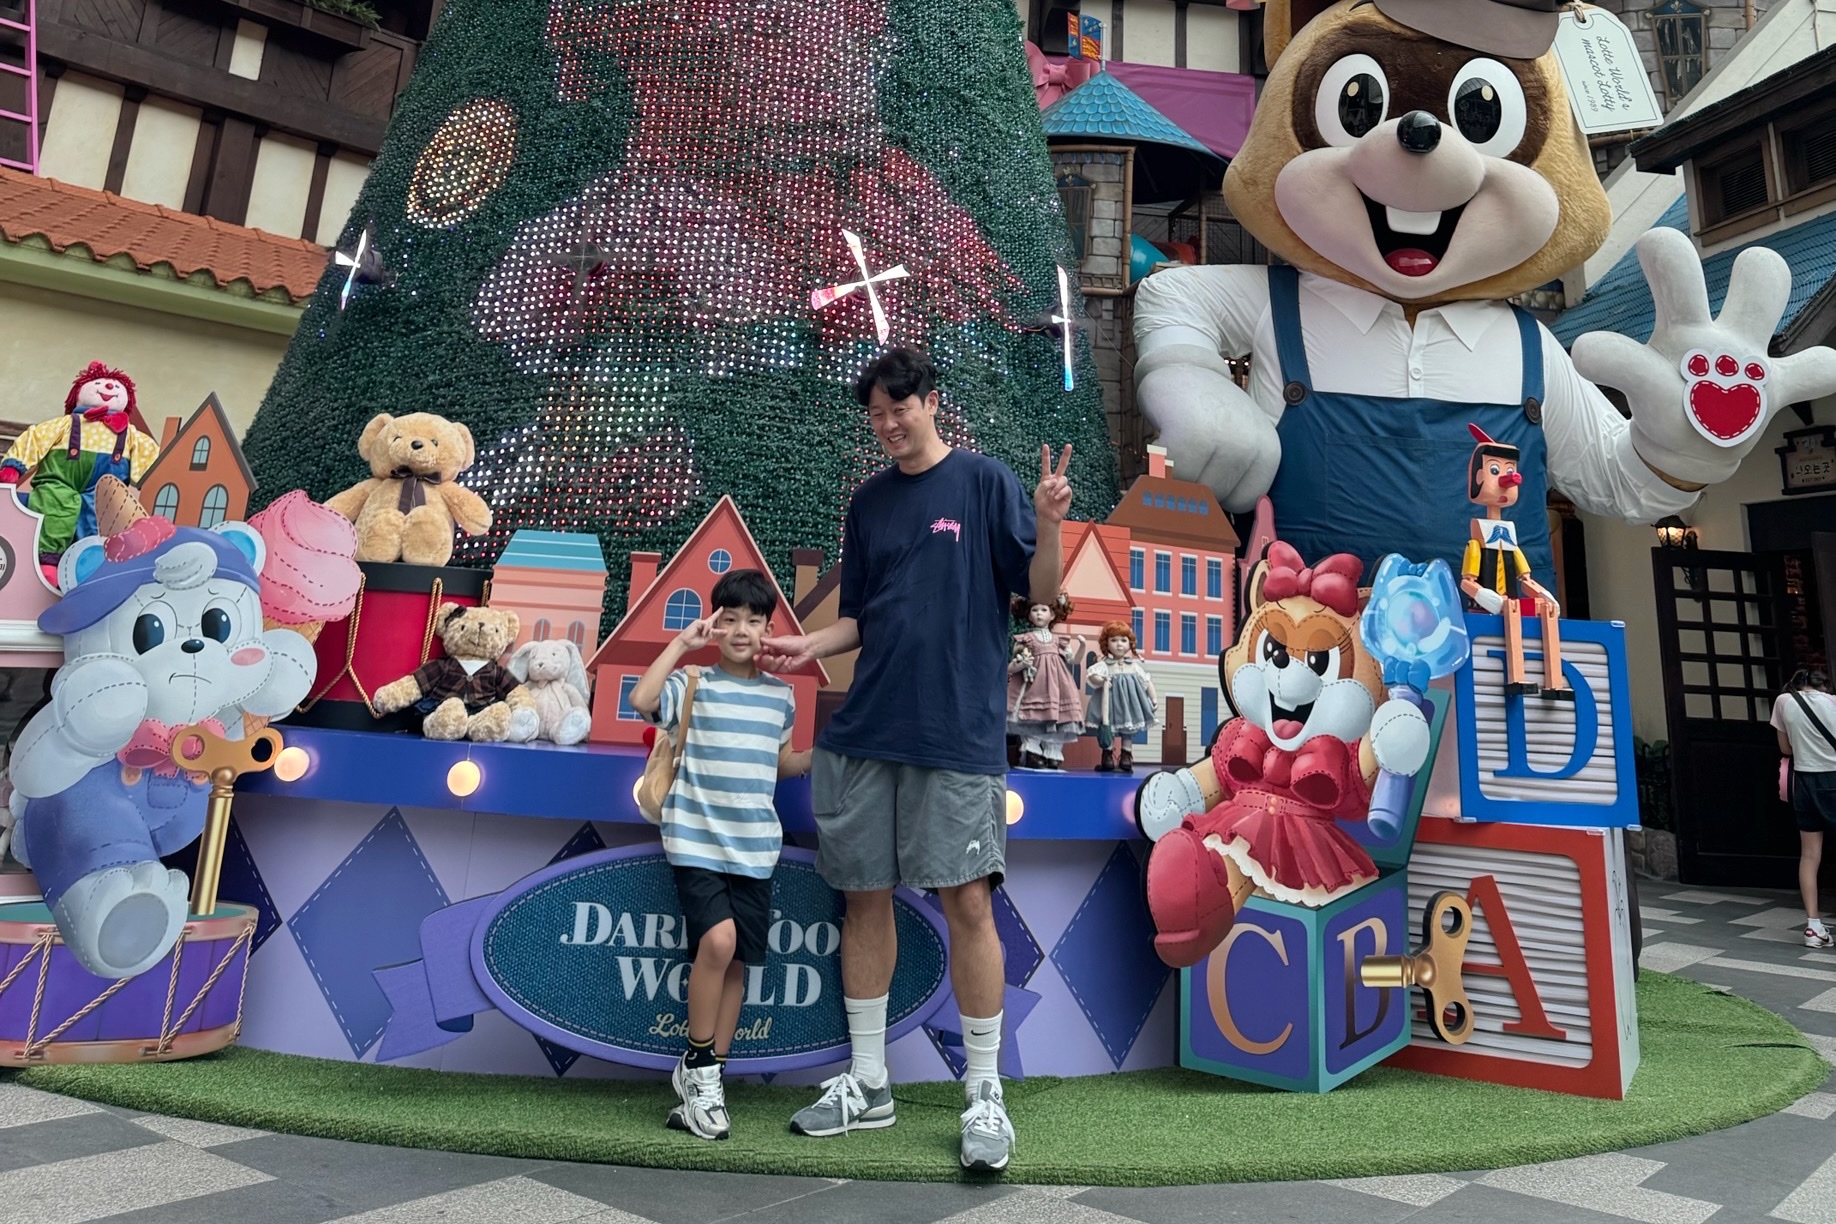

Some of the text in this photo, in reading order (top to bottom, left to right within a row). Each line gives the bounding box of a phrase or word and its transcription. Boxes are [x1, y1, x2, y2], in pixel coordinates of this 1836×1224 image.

[1488, 650, 1598, 778] D
[614, 955, 822, 1008] WOLD
[1206, 921, 1294, 1055] C
[734, 1016, 772, 1041] orld
